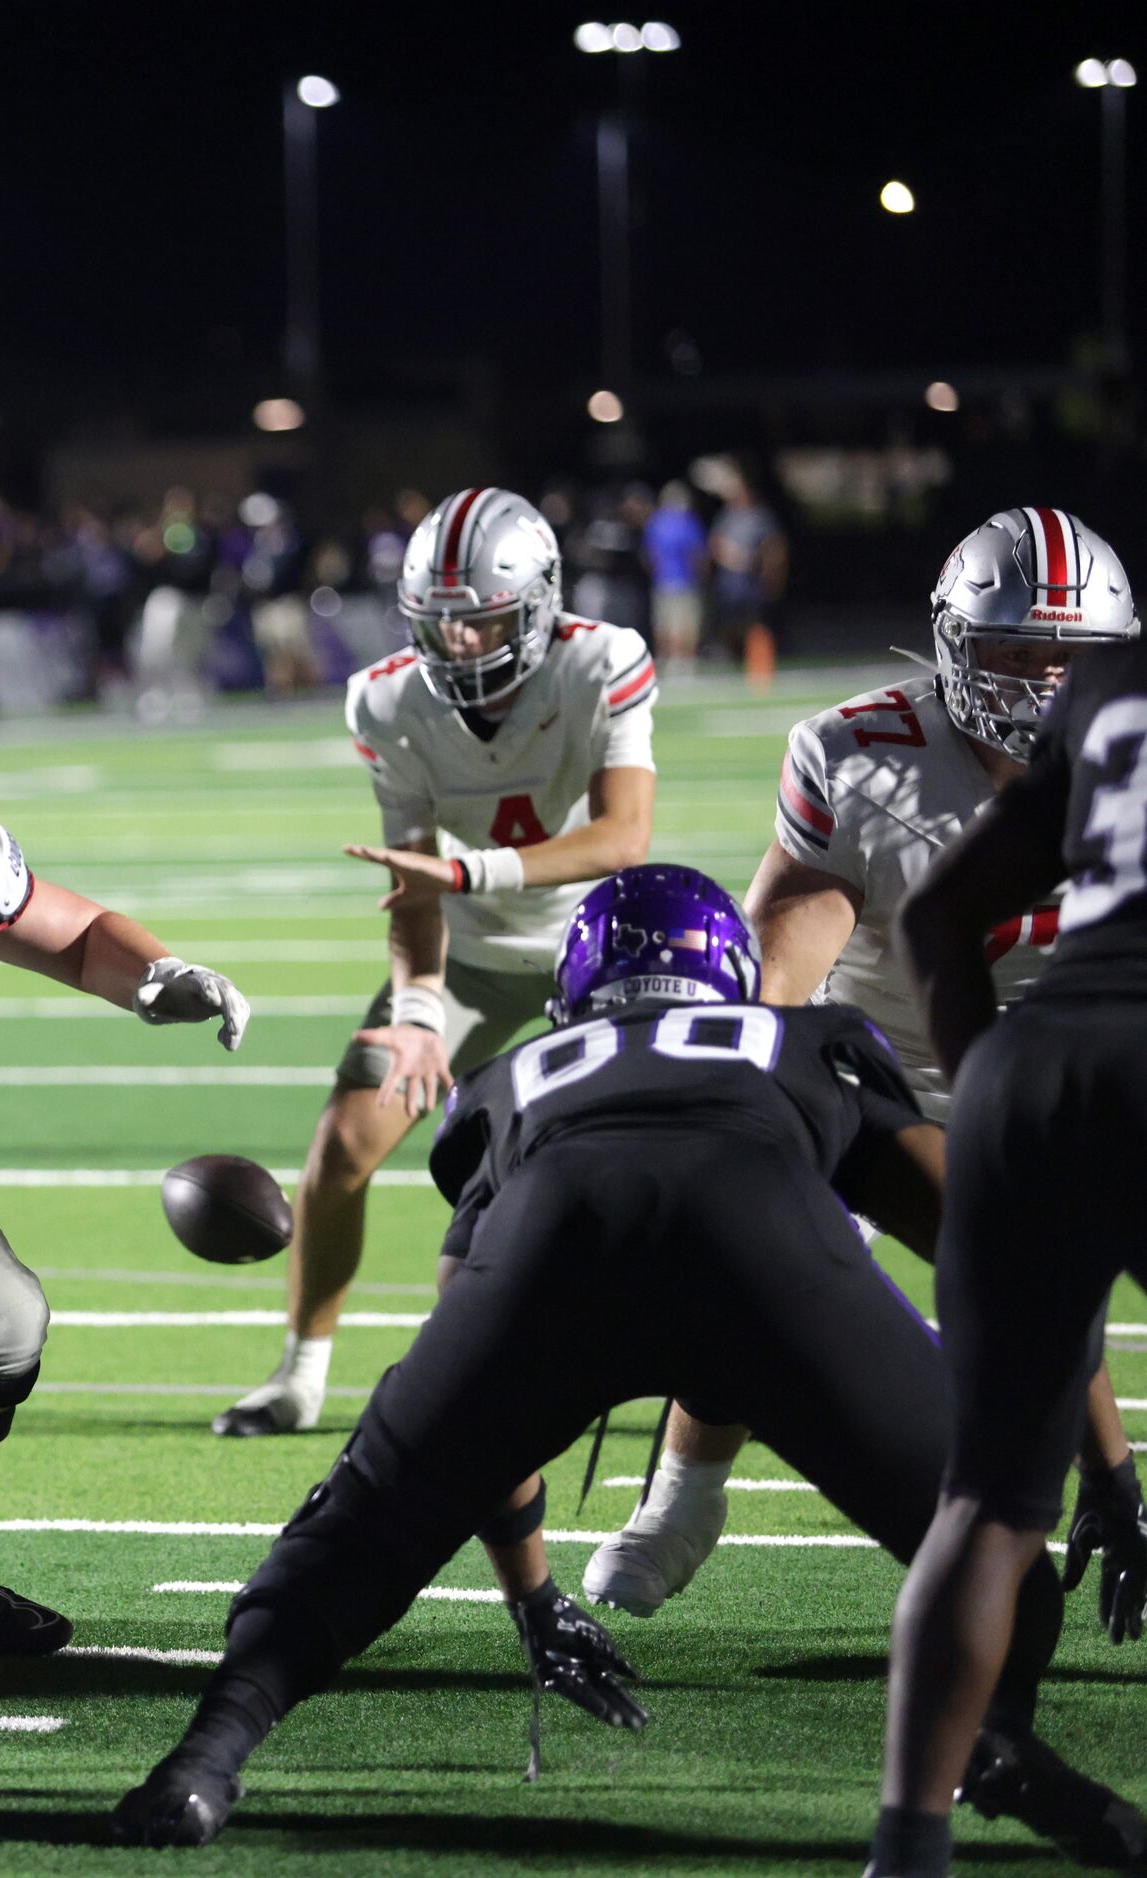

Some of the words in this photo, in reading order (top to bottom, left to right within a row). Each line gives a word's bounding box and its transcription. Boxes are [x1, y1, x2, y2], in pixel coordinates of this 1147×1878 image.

[1030, 608, 1083, 623] Riddell
[838, 689, 927, 749] 77
[490, 794, 551, 850] 4
[623, 976, 682, 996] COYOTE
[687, 980, 698, 997] U
